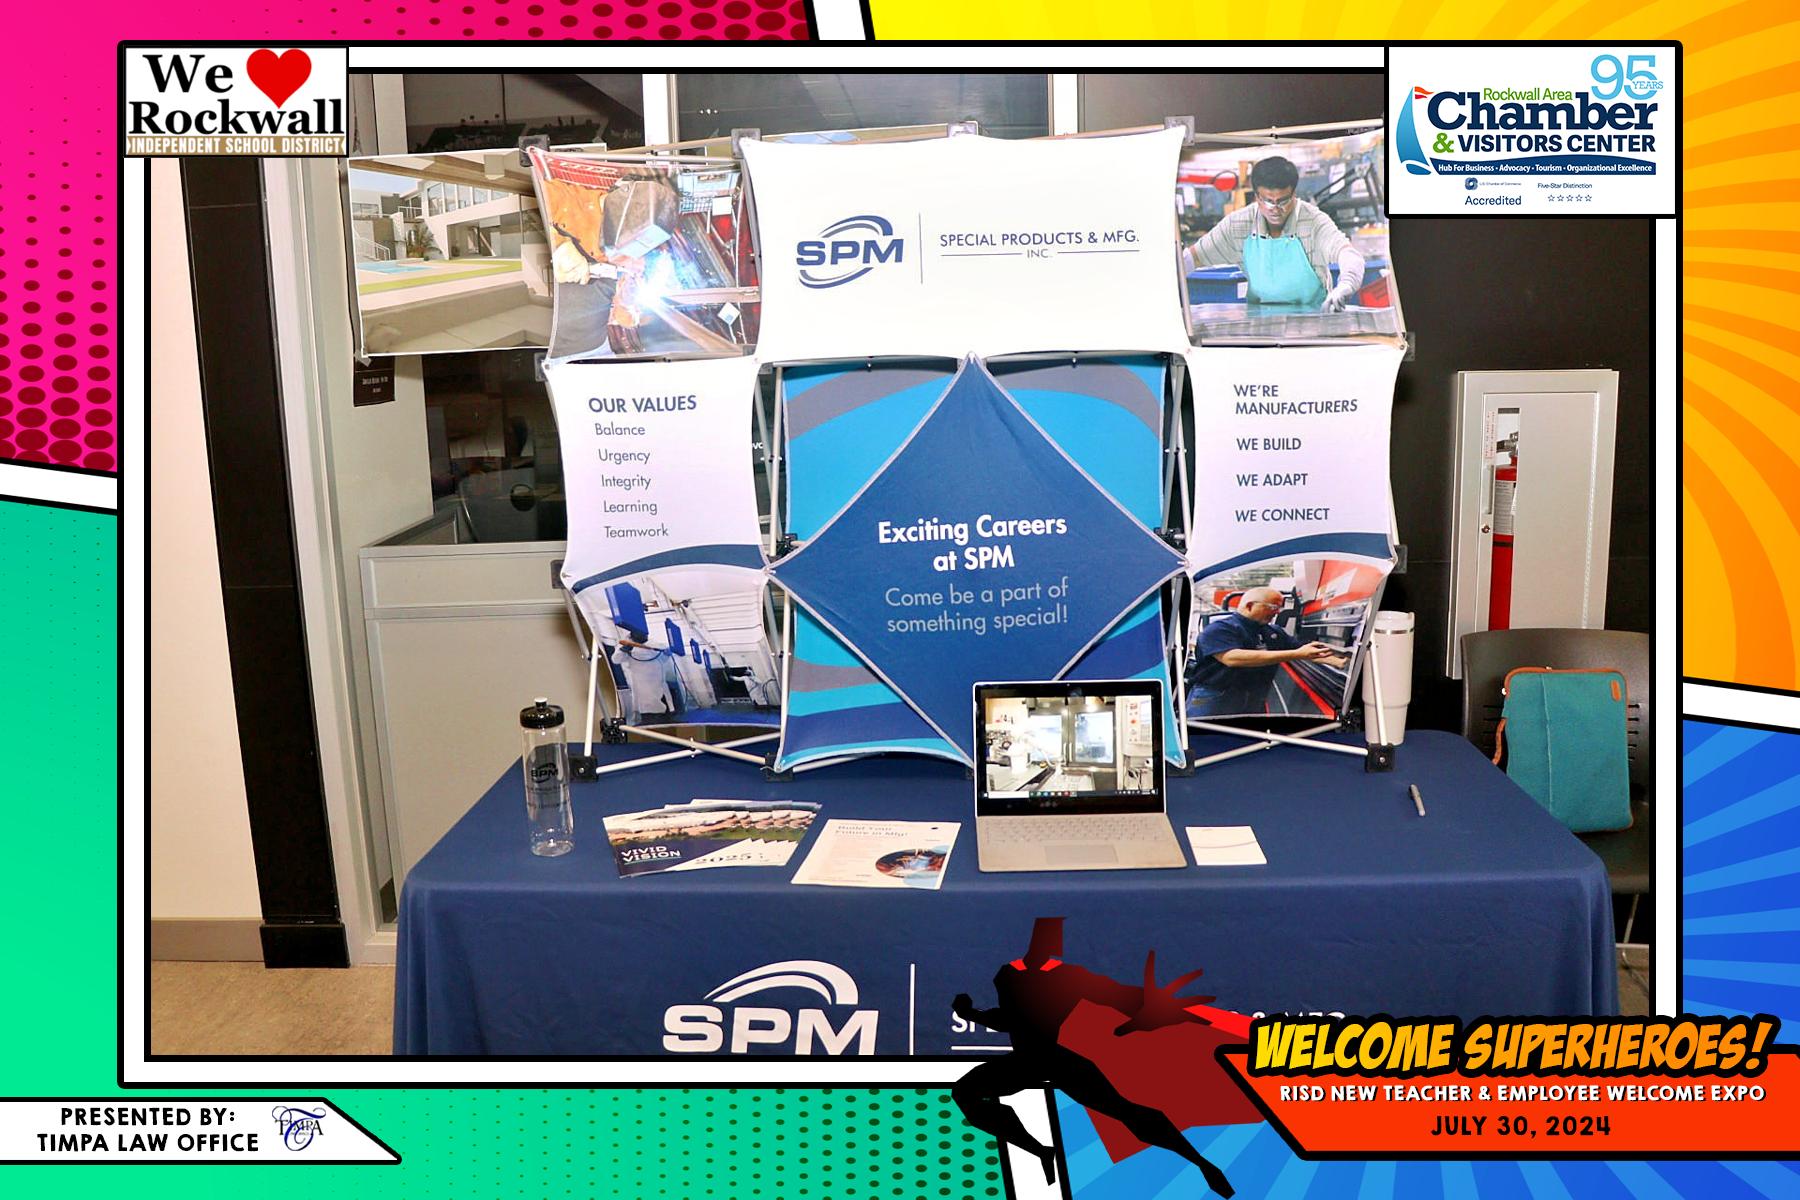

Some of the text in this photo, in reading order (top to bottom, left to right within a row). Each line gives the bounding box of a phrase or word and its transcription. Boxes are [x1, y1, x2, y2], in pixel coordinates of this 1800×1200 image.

[940, 229, 1140, 247] SPECIAL PRODUCTS & MFG.
[796, 238, 904, 266] SPM
[1027, 248, 1053, 259] INC.
[588, 394, 697, 413] OUR VALUES
[1235, 399, 1358, 415] MANUFACTURERS
[594, 421, 646, 436] Balance
[1236, 438, 1302, 451] WE BUILD
[598, 448, 651, 465] Urgency
[601, 474, 651, 490] Integrity
[1236, 473, 1308, 487] WE ADAPT
[603, 500, 658, 515] Learning
[1235, 508, 1330, 522] WE CONNECT
[604, 523, 669, 538] Teamwork
[878, 514, 1068, 546] Exciting Careers
[933, 544, 1015, 572] at SPM
[885, 576, 1069, 607] Come be a part of
[887, 602, 1069, 636] something special!
[621, 845, 668, 857] VIVID
[623, 850, 681, 863] VISION
[662, 1004, 879, 1055] SPM
